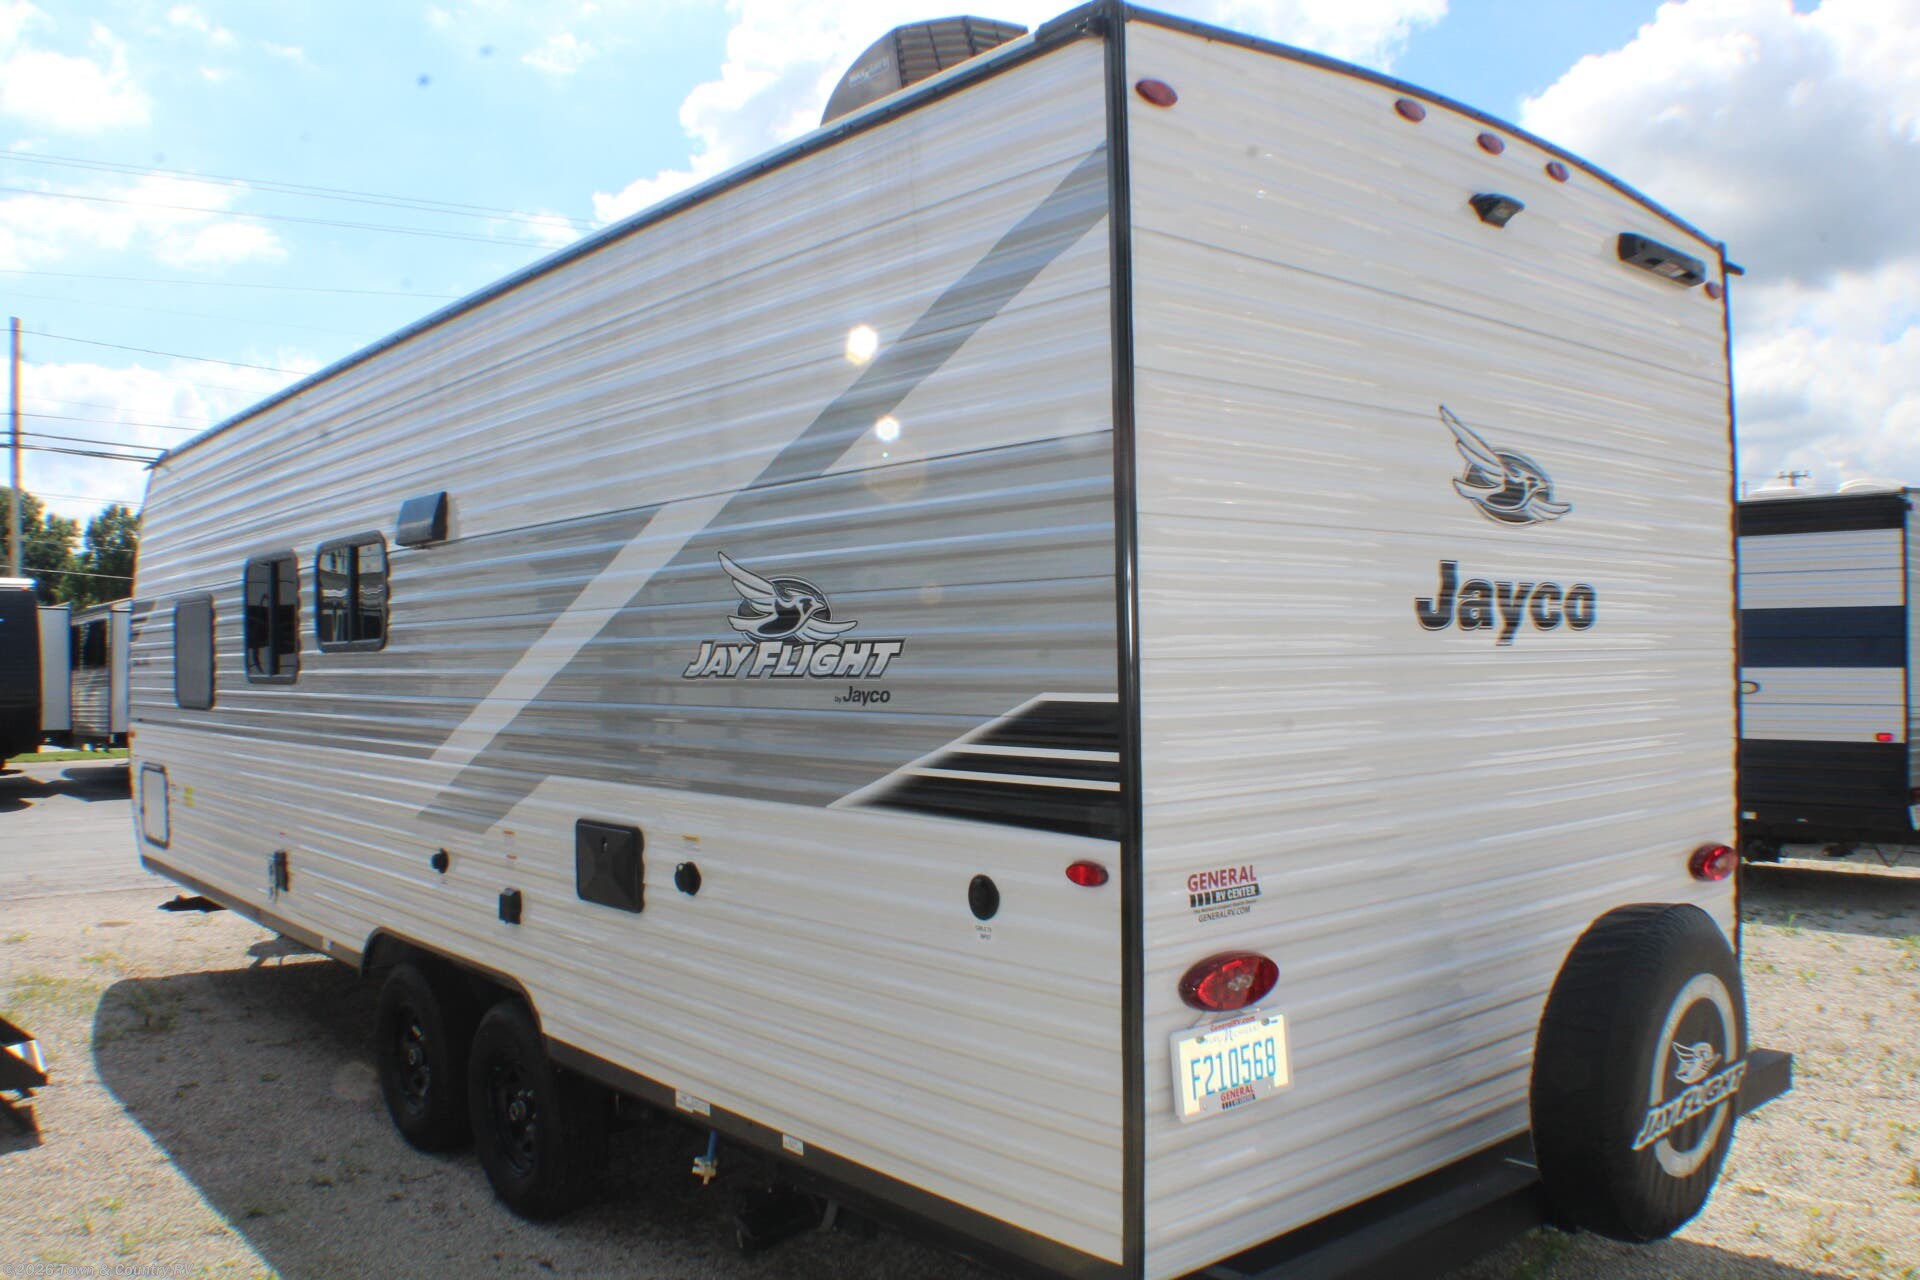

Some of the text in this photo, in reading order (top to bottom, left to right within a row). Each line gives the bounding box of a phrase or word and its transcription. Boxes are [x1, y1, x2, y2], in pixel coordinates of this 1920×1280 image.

[1414, 560, 1597, 646] Jayco
[682, 639, 905, 679] JAY FLIGHT
[843, 686, 891, 706] Jayco
[1187, 865, 1257, 892] GENERAL
[1215, 885, 1256, 902] RV CENTER
[1190, 1037, 1276, 1100] F210568
[1220, 1084, 1255, 1101] GENERAL
